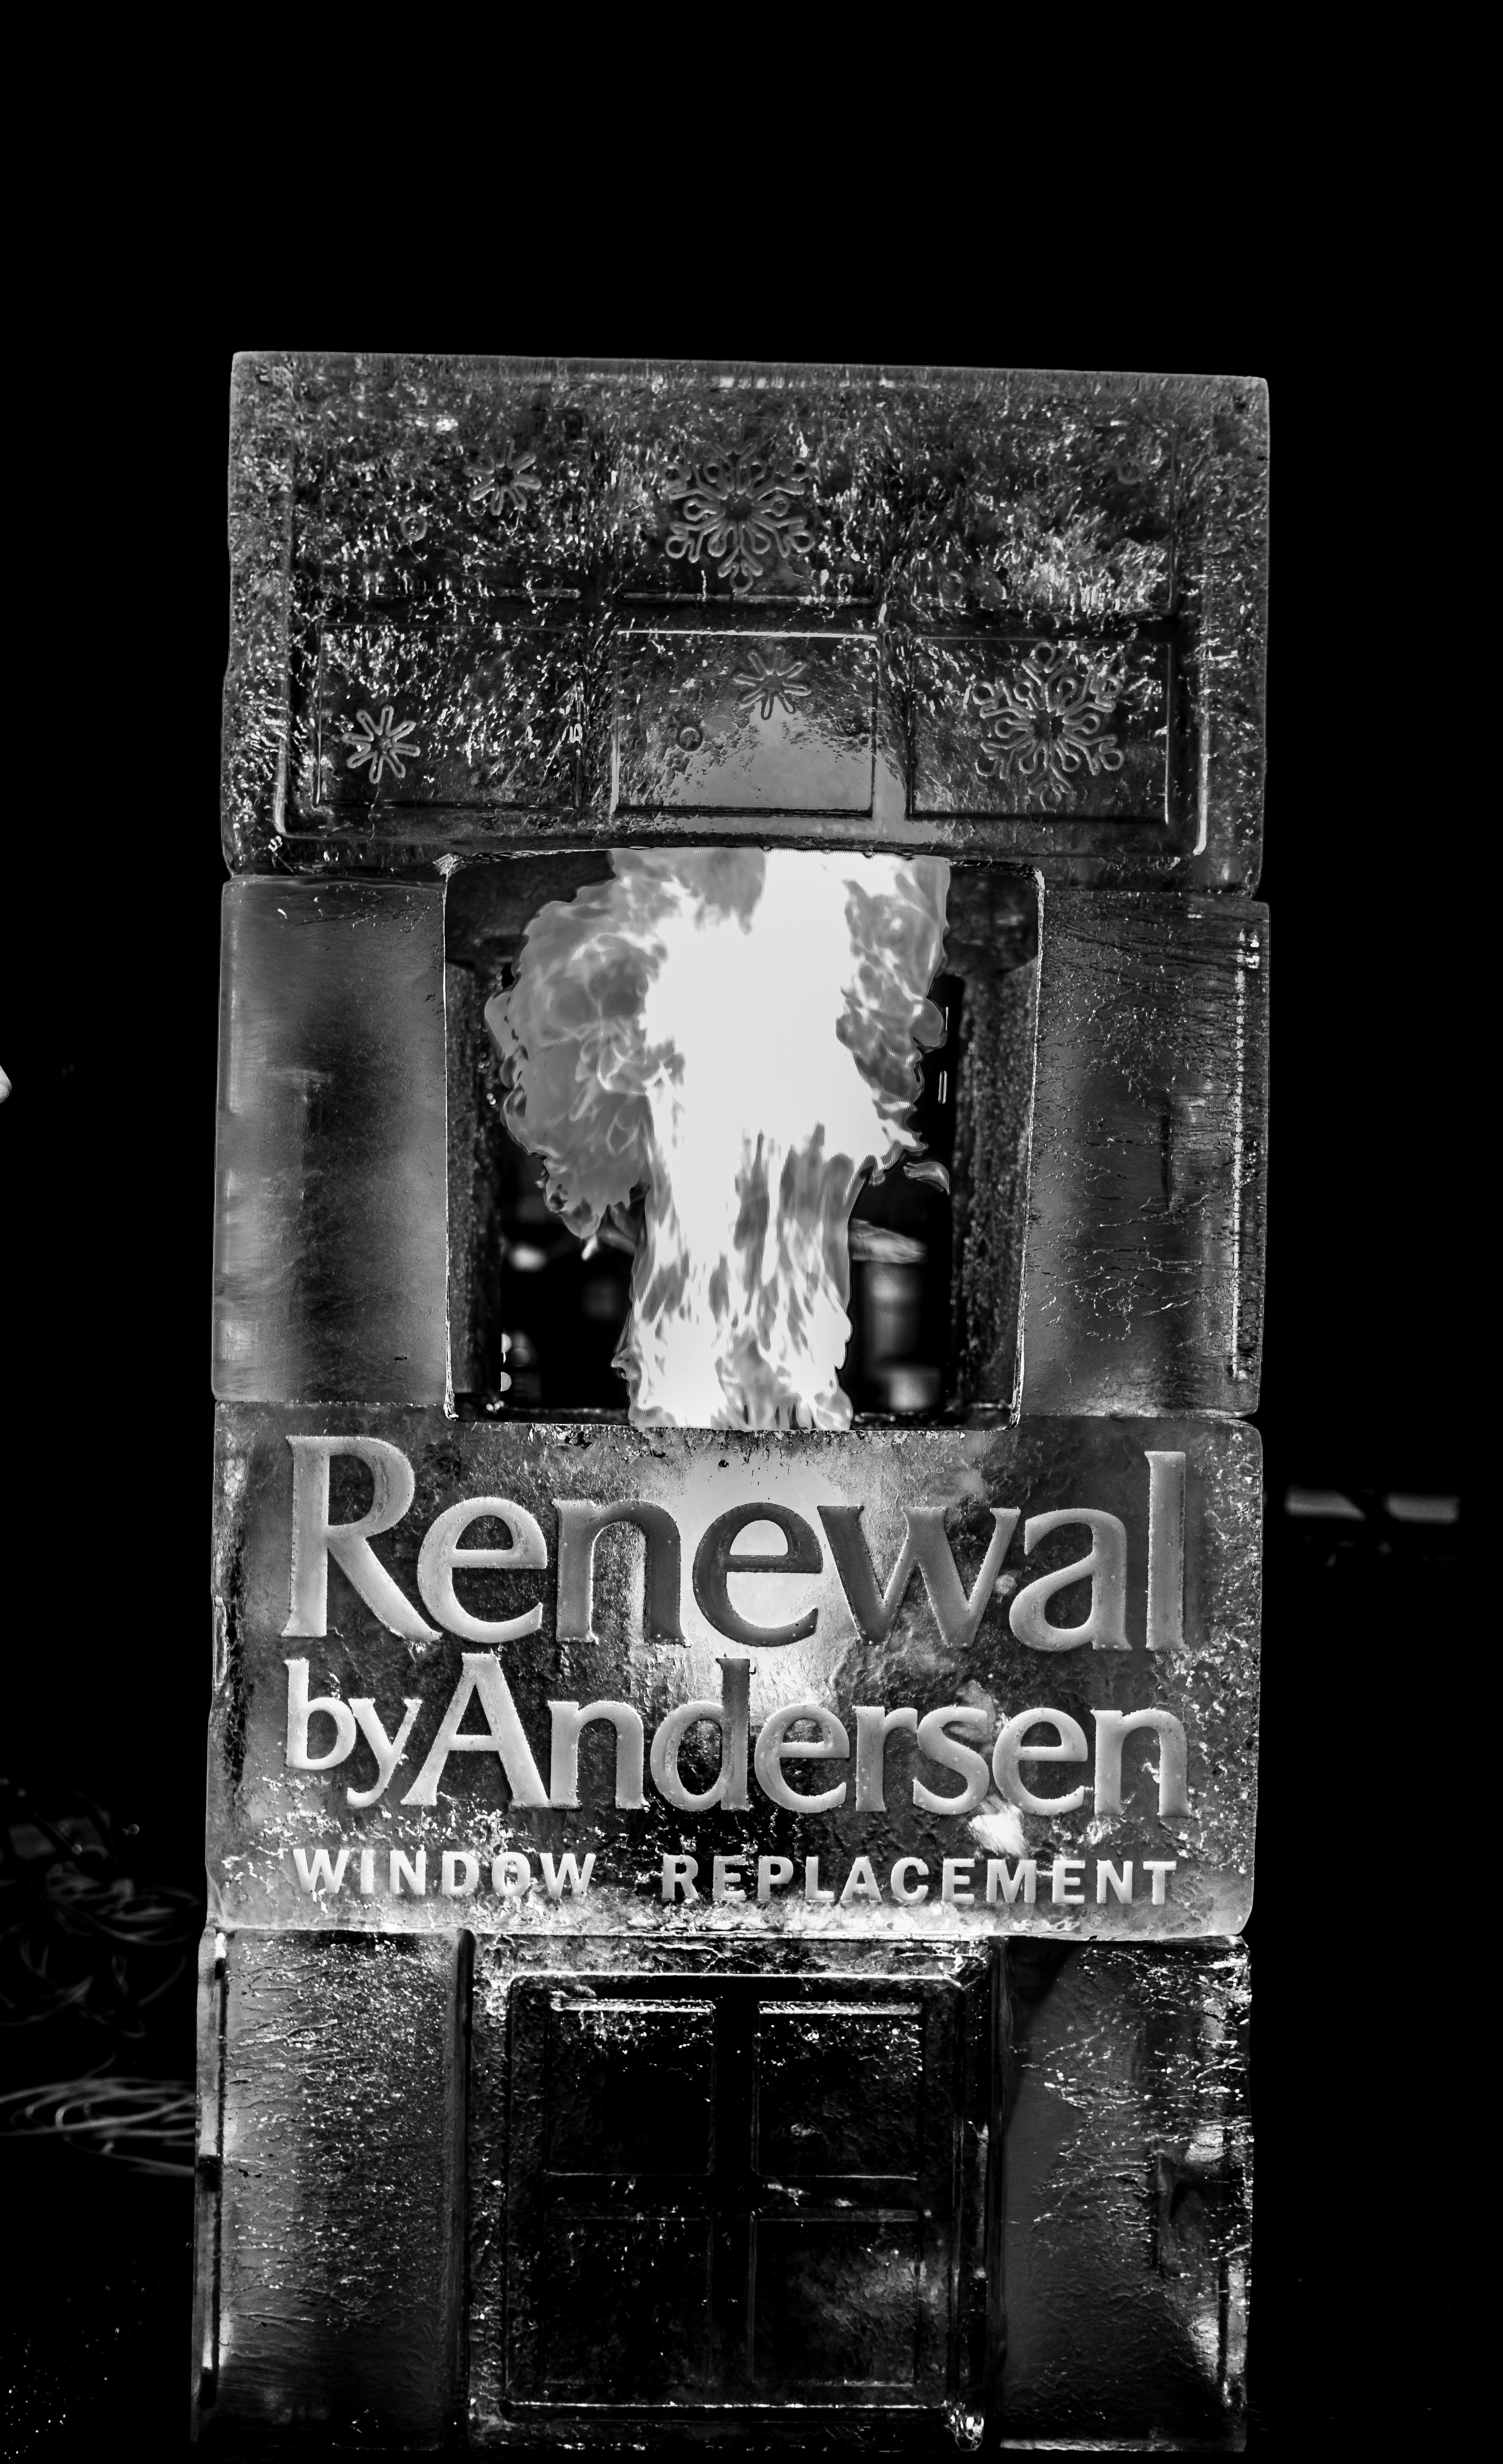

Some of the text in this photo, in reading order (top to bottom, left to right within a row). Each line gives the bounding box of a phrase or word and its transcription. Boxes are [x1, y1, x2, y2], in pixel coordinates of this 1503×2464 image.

[281, 1435, 1187, 1651] Renewal
[292, 1848, 1178, 1905] WINDOW REPLACEMENT
